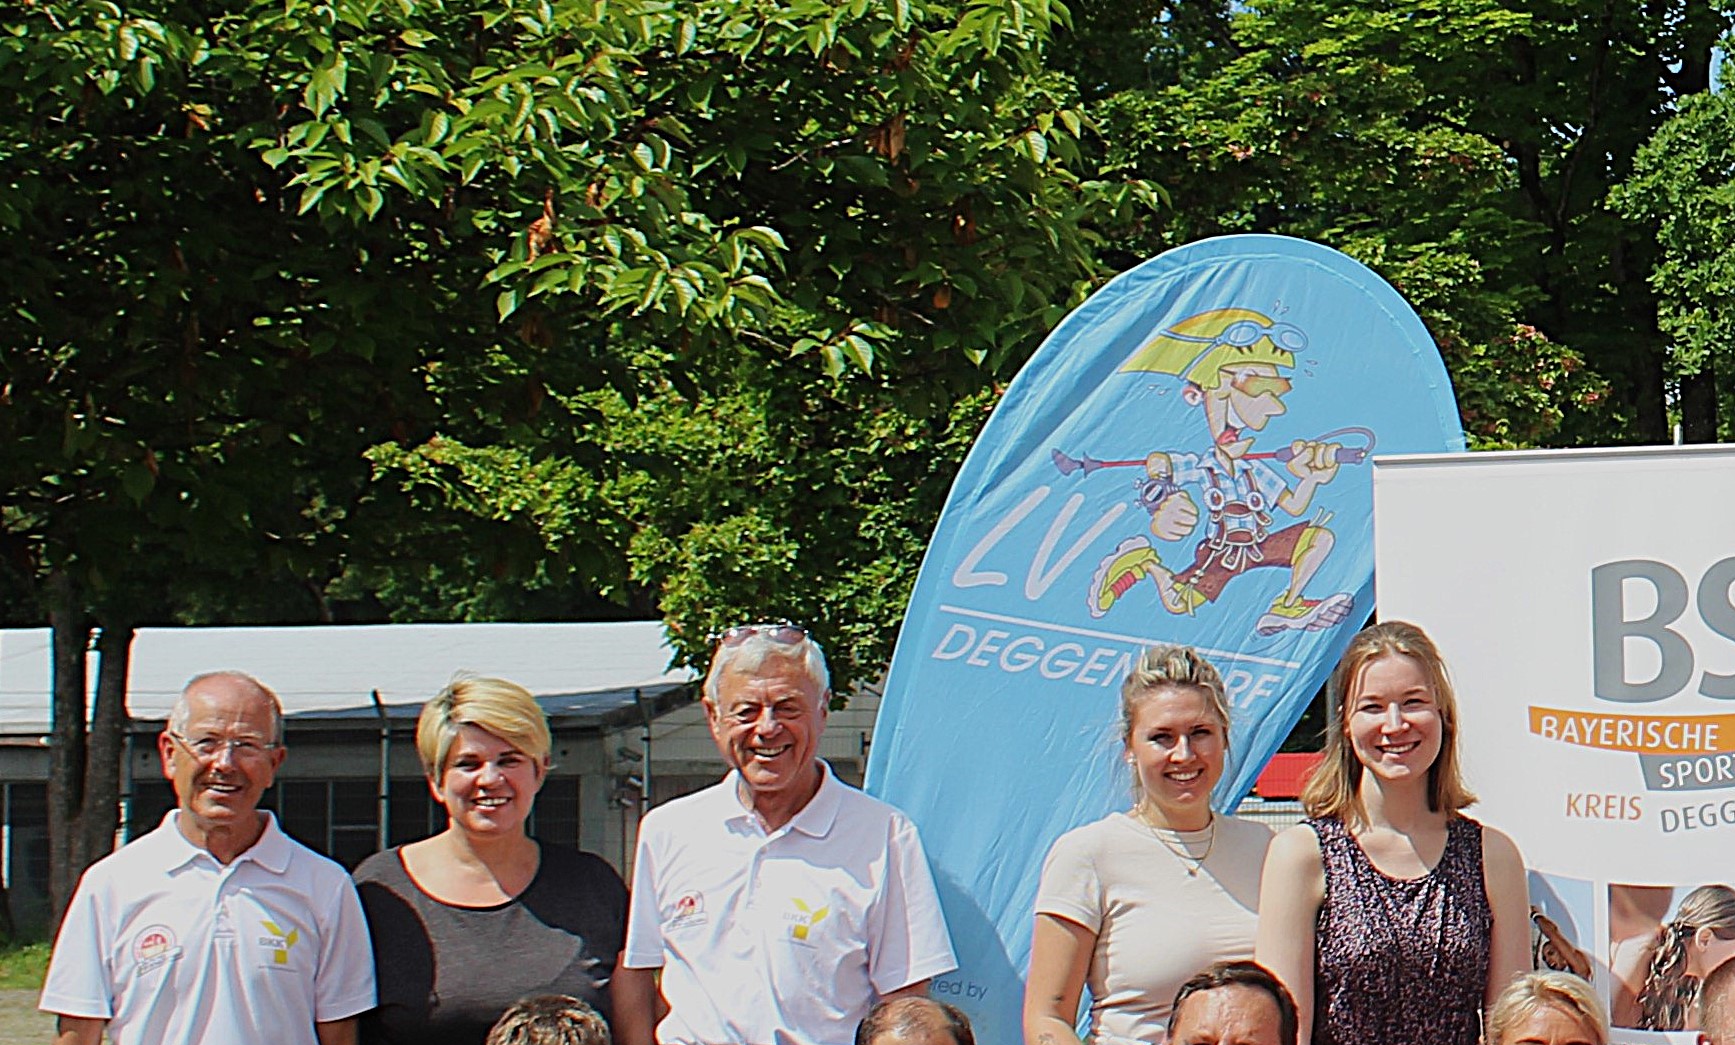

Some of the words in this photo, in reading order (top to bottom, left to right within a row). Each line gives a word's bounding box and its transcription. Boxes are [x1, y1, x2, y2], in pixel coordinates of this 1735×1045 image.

[952, 485, 1128, 601] LV
[1540, 715, 1719, 751] BAYERISCHE
[1565, 792, 1643, 821] KREIS
[966, 980, 988, 1000] by
